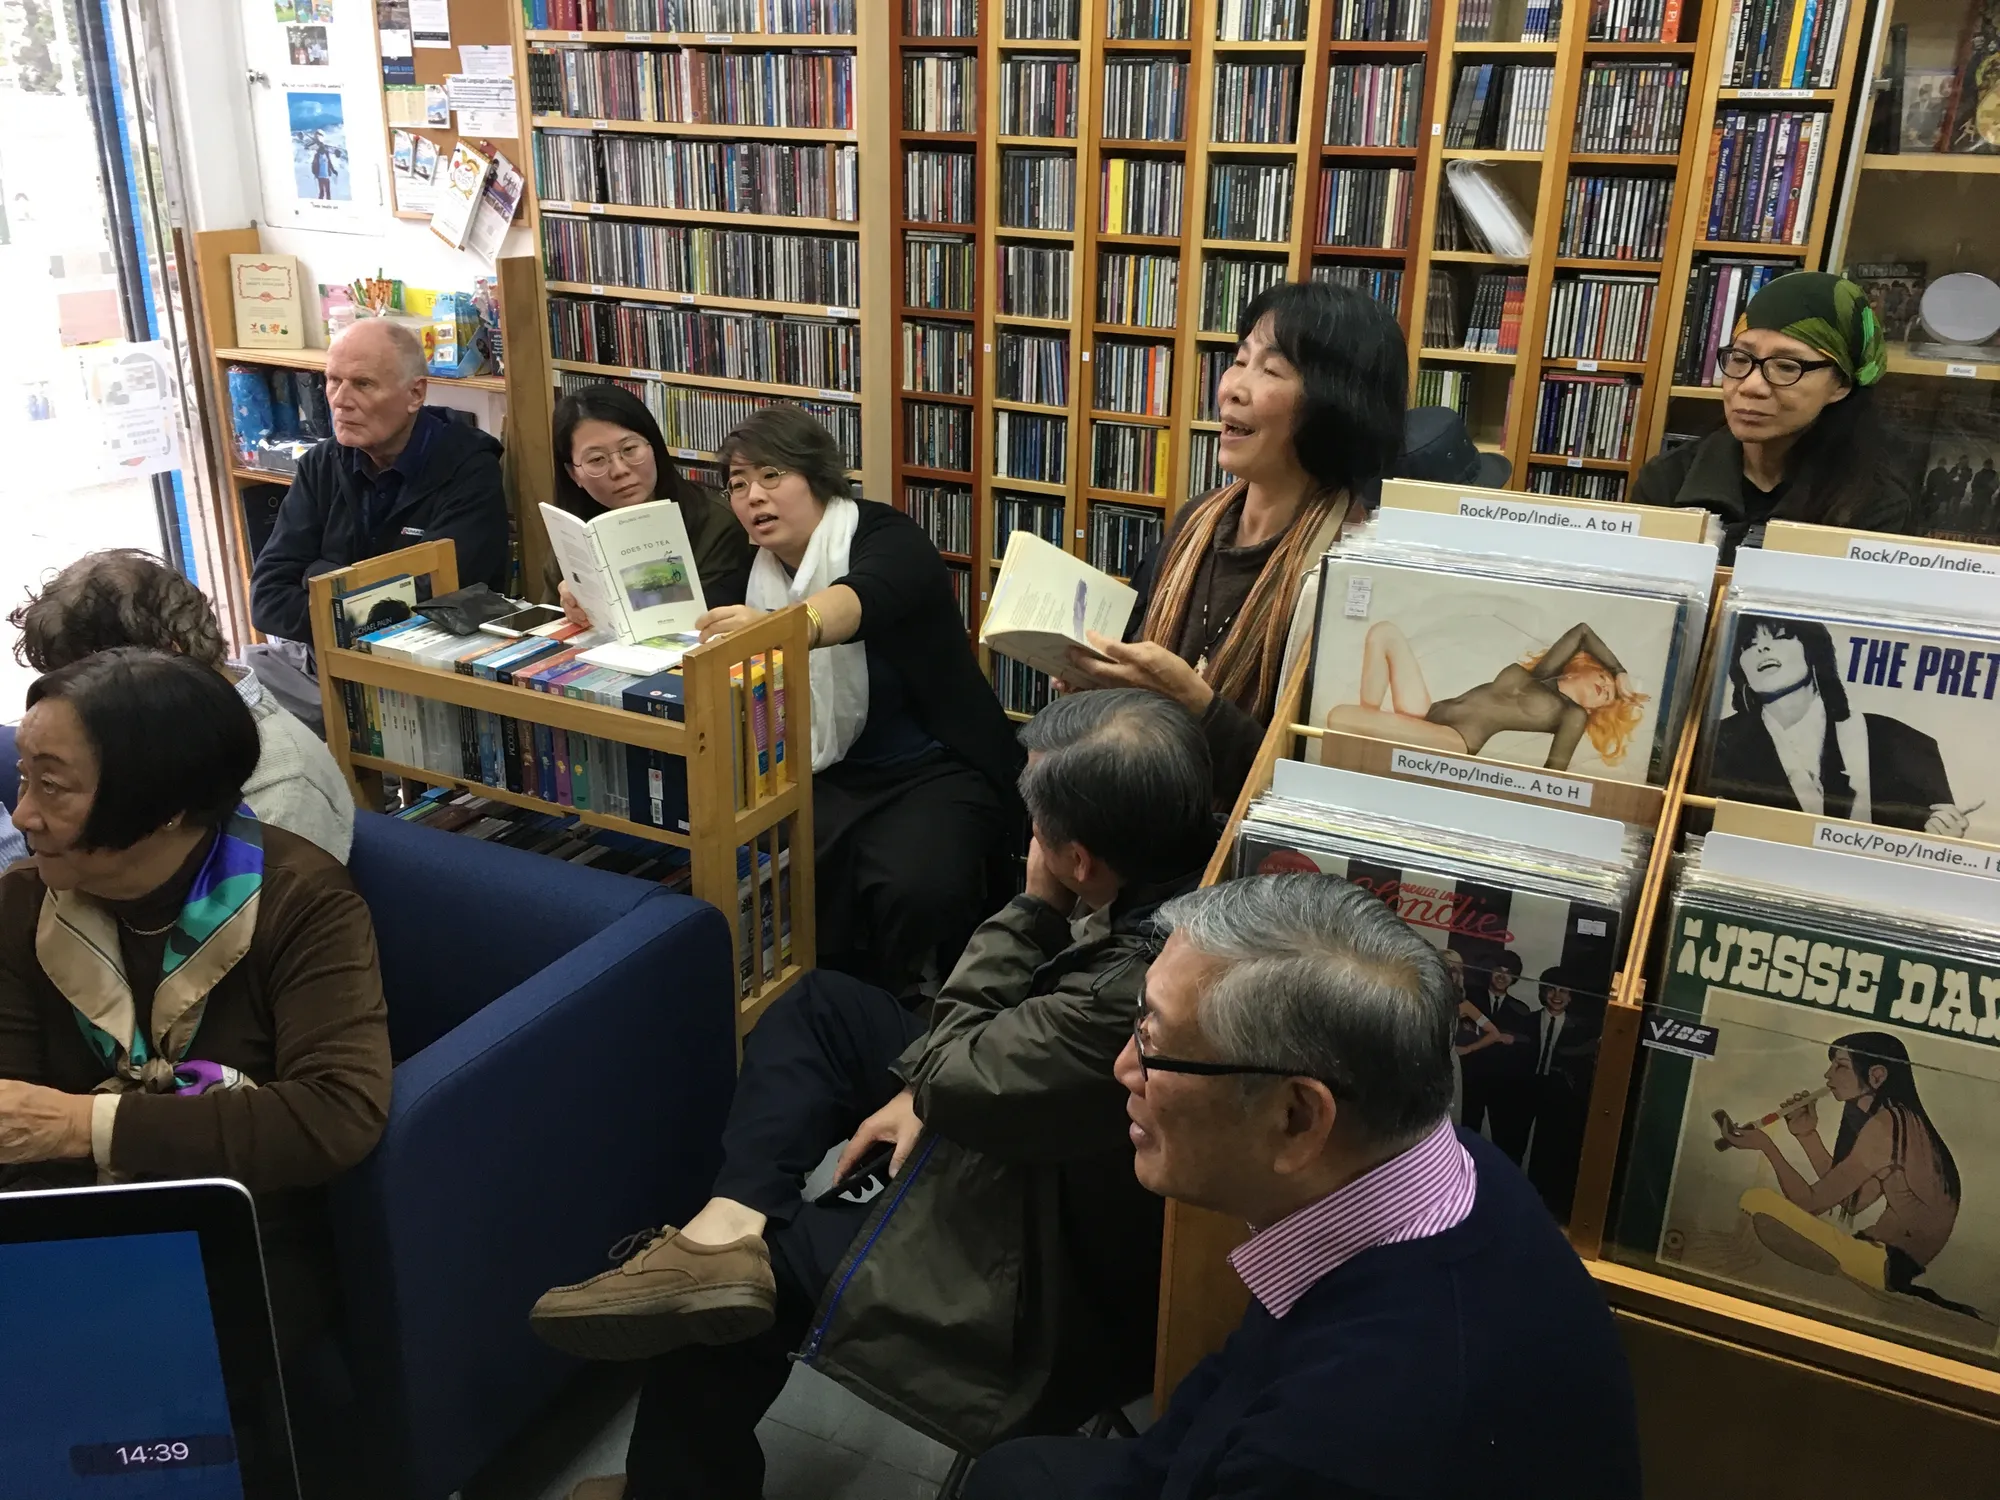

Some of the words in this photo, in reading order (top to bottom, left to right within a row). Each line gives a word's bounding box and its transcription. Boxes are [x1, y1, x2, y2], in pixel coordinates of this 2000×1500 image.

[1813, 119, 1823, 136] THE
[1807, 141, 1818, 176] POLICE
[1460, 503, 1581, 529] Rock/Pop/Indie...
[1585, 517, 1597, 530] A
[1601, 519, 1617, 532] to
[1621, 520, 1633, 534] H
[620, 545, 642, 557] ODES
[643, 542, 654, 552] TO
[656, 539, 671, 549] TEA
[1850, 546, 1995, 575] Rock/Pop/Indie...
[349, 620, 378, 638] MICHAEL
[376, 616, 393, 629] PALIN
[1847, 636, 1910, 689] THE
[1913, 645, 2000, 700] PRET
[1398, 754, 1526, 790] Rock/Pop/Indie...
[1530, 779, 1542, 793] A
[1546, 781, 1563, 796] to
[1567, 785, 1580, 799] H
[1820, 827, 1978, 869] Rock/Pop/Indie...
[116, 1442, 189, 1465] 14:39
